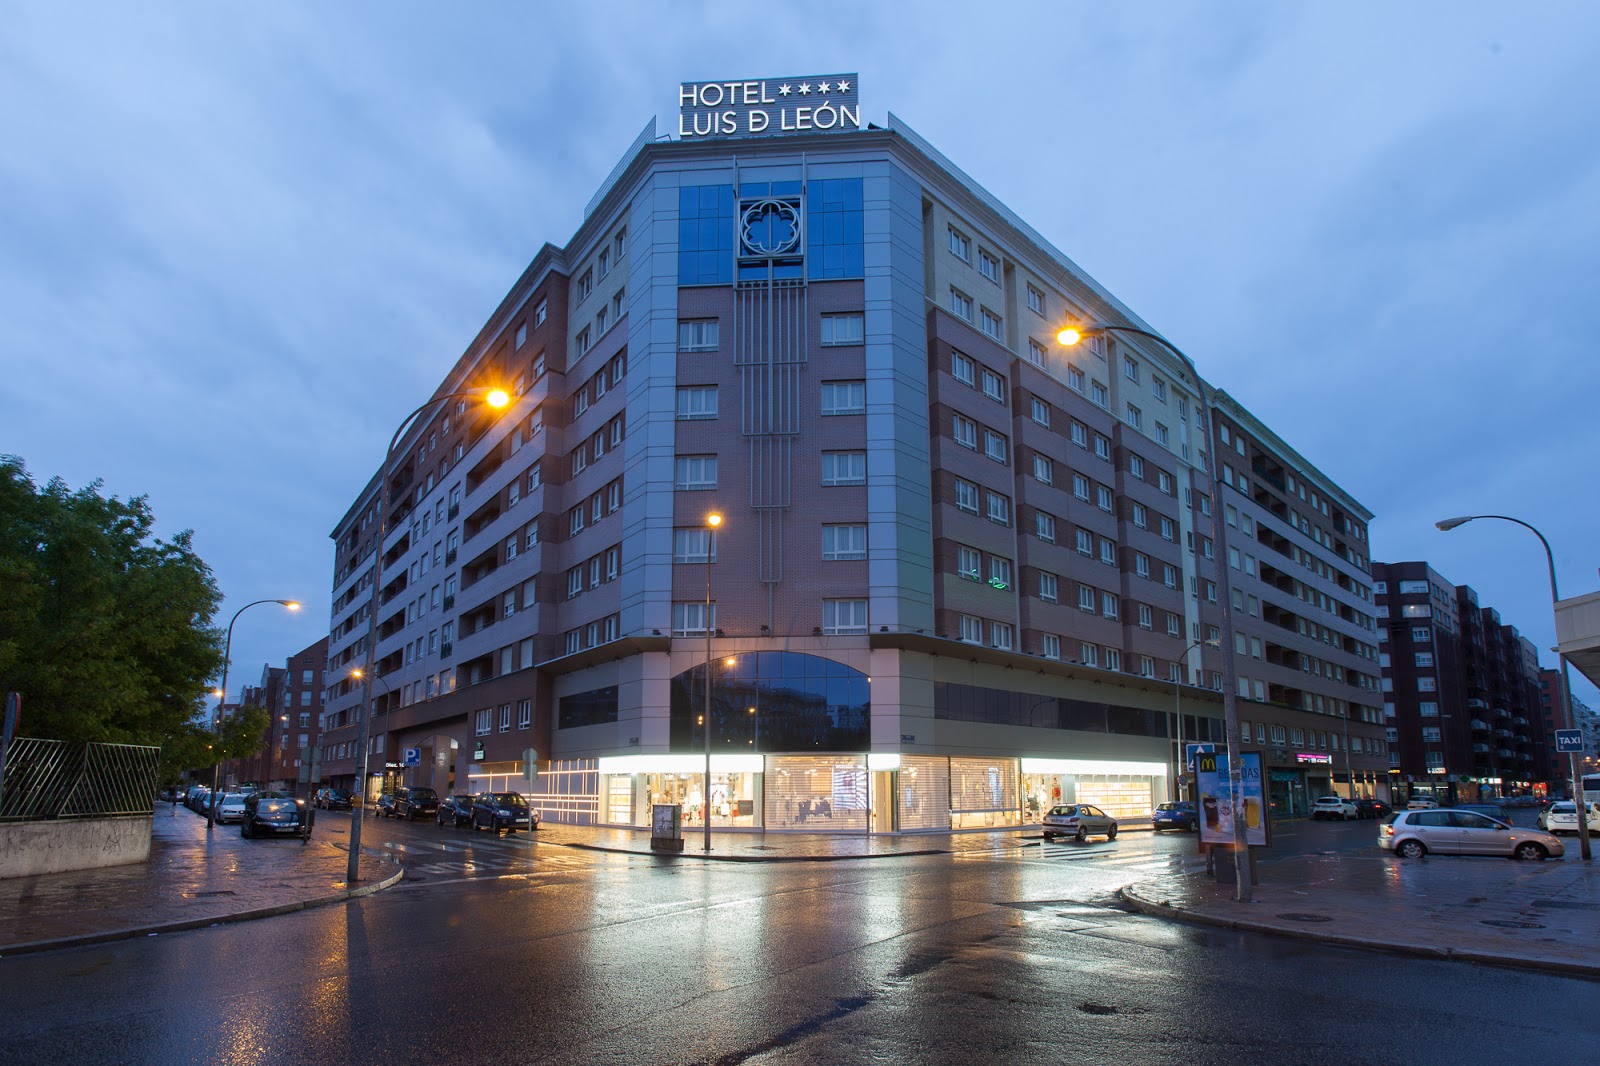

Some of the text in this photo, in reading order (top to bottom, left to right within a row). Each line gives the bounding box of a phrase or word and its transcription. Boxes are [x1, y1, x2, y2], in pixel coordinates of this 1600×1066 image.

[679, 81, 775, 107] HOTEL
[679, 111, 737, 136] LUIS
[781, 100, 860, 131] LEÓN
[1558, 736, 1581, 745] TAXI
[405, 749, 416, 762] P
[1218, 767, 1259, 779] BEDAS
